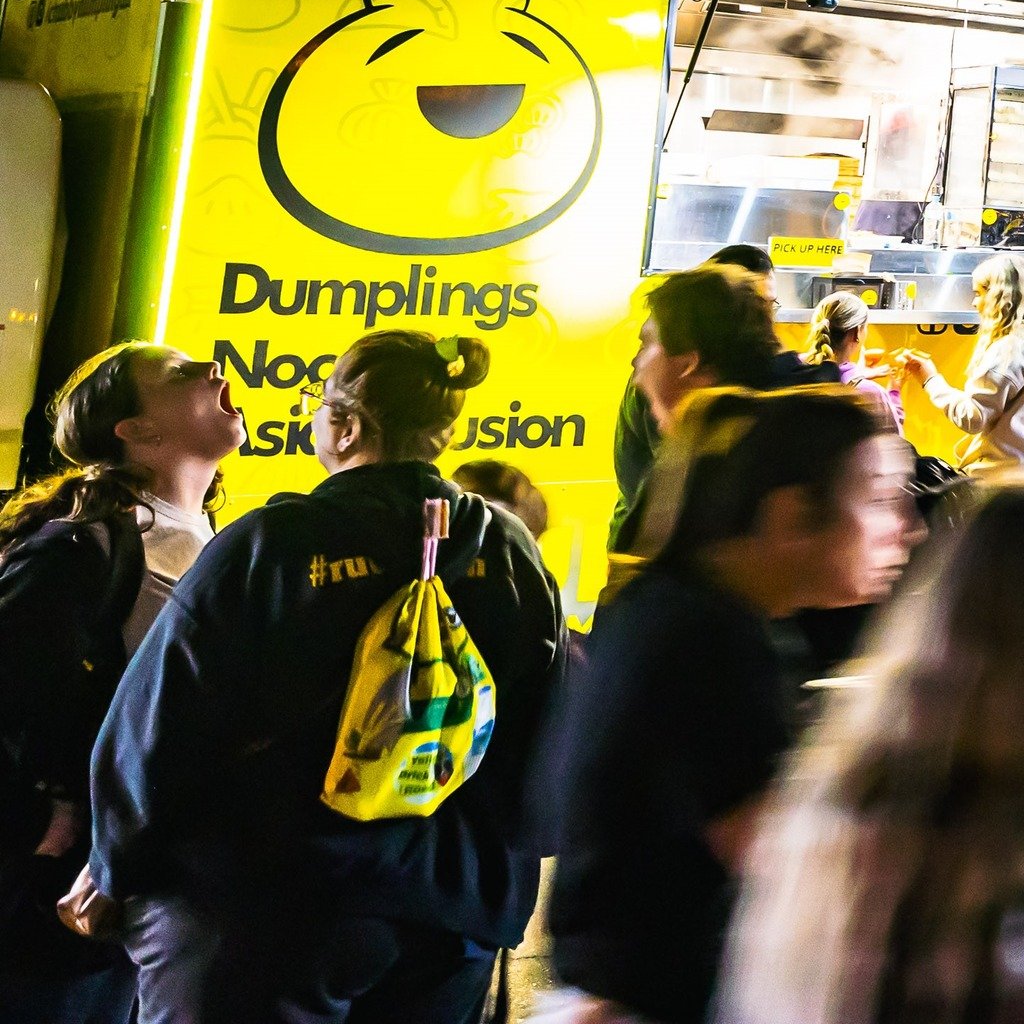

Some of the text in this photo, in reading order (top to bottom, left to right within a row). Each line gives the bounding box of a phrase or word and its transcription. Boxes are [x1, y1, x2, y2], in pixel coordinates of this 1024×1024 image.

[773, 243, 843, 254] PICK UP HERE
[218, 262, 539, 330] Dumplings
[213, 340, 338, 388] Noo
[450, 400, 586, 451] usion
